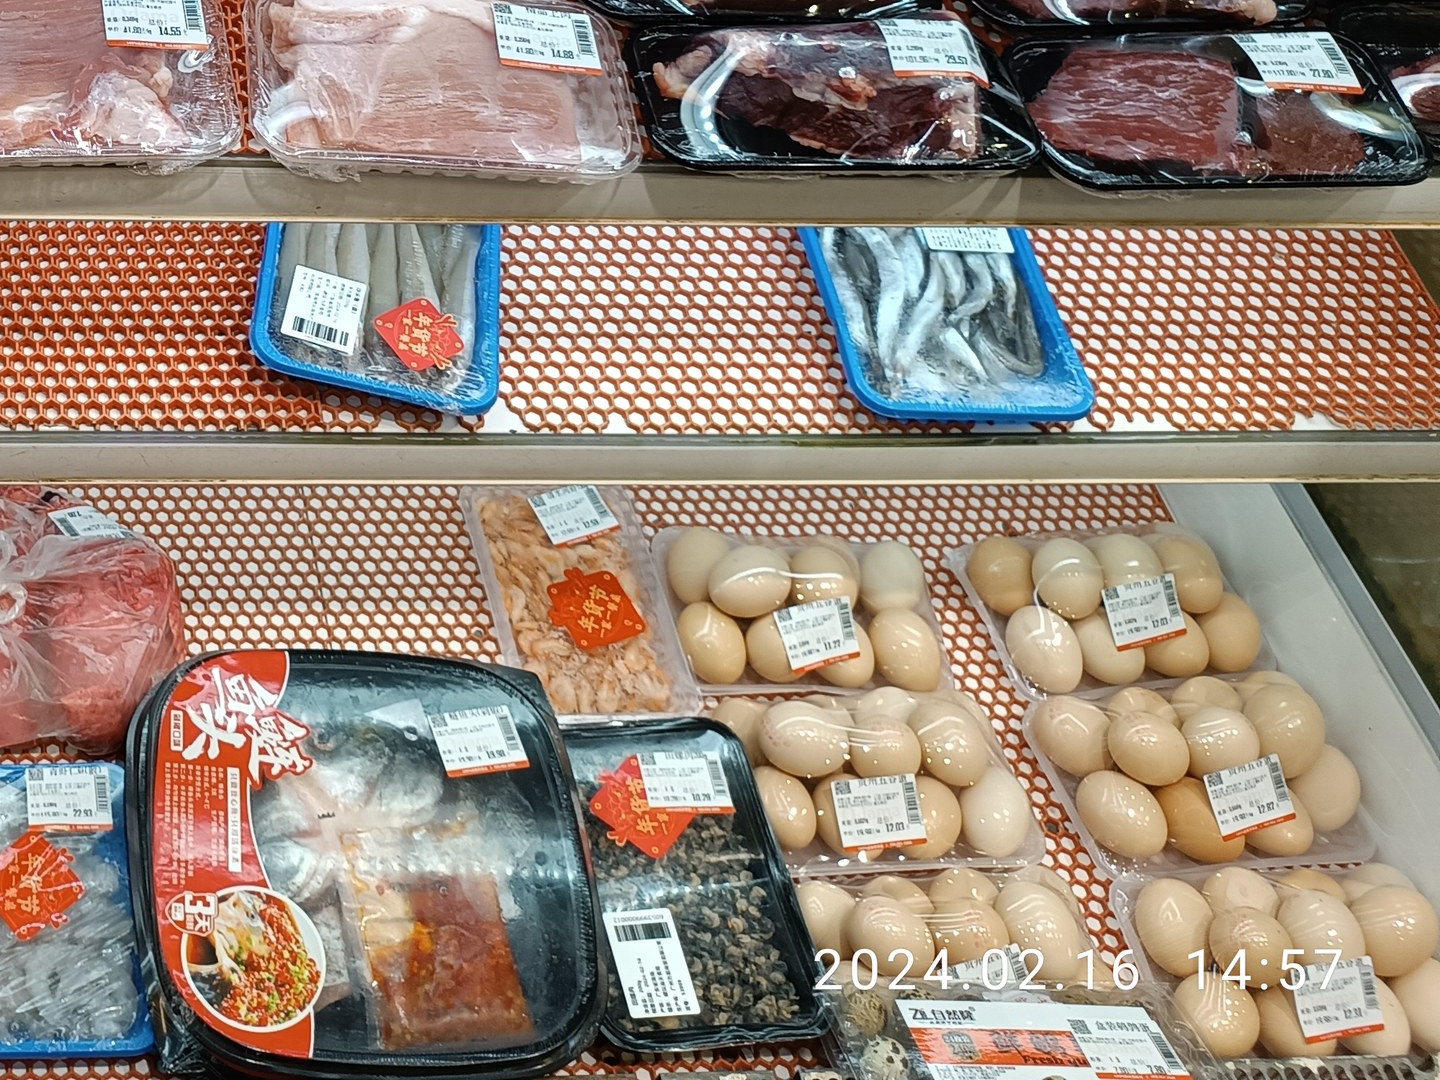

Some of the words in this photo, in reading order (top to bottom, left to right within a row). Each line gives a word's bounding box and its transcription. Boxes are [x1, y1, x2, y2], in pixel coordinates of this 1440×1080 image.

[159, 26, 182, 36] 14.55
[552, 49, 574, 59] 14.88
[408, 311, 434, 357] 年货节
[577, 584, 609, 633] 年货节
[16, 853, 45, 915] 年货节
